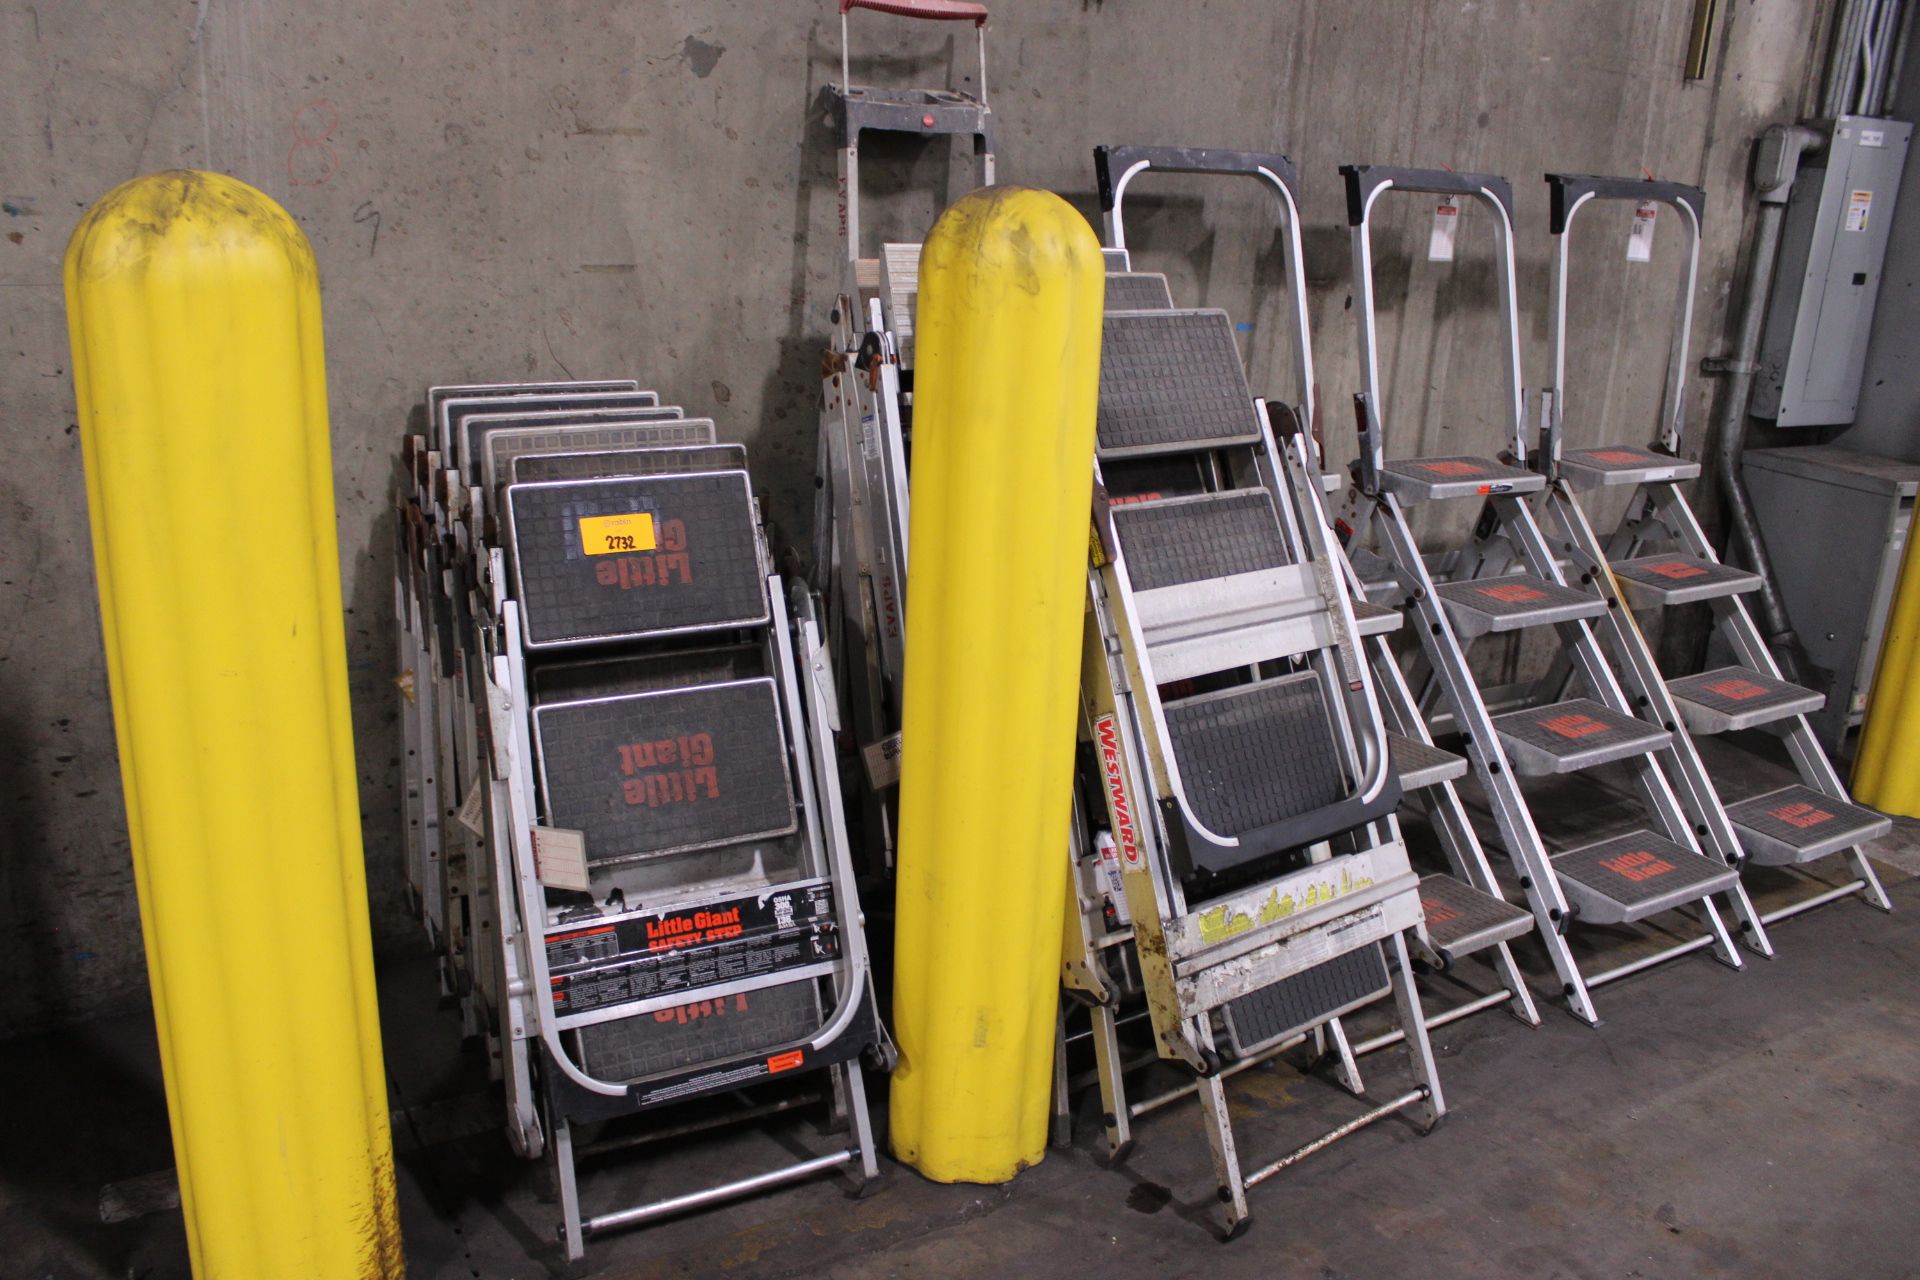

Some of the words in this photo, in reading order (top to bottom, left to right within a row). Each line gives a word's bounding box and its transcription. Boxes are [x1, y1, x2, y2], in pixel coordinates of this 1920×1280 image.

[605, 535, 637, 550] 2732
[595, 553, 693, 590] Little
[617, 733, 715, 777] Giant
[623, 767, 720, 808] Little
[1097, 718, 1139, 864] WESTWARD
[773, 894, 792, 903] OSHA
[646, 916, 693, 938] Little
[694, 907, 740, 929] Giant
[648, 931, 702, 953] SAFETY
[706, 924, 742, 942] STEP
